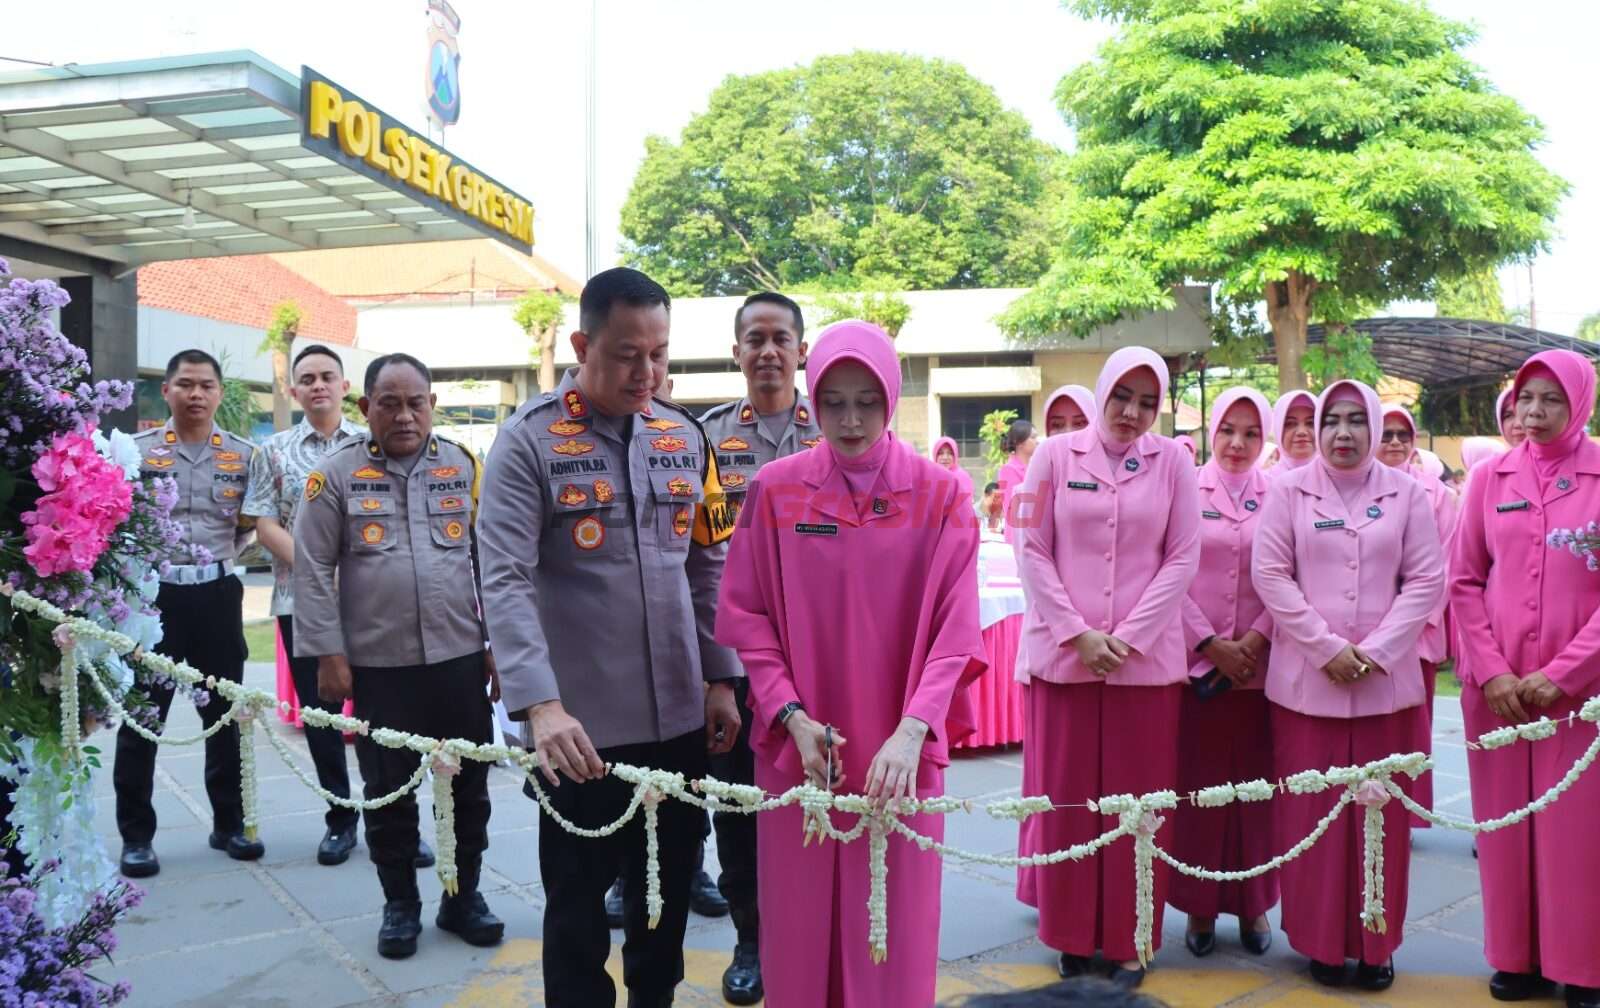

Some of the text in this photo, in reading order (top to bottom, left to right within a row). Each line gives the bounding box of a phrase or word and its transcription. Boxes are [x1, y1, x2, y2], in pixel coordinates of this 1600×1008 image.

[310, 81, 535, 246] POLSEK GRESIK
[648, 456, 697, 469] POLRI
[428, 480, 467, 492] POLRI
